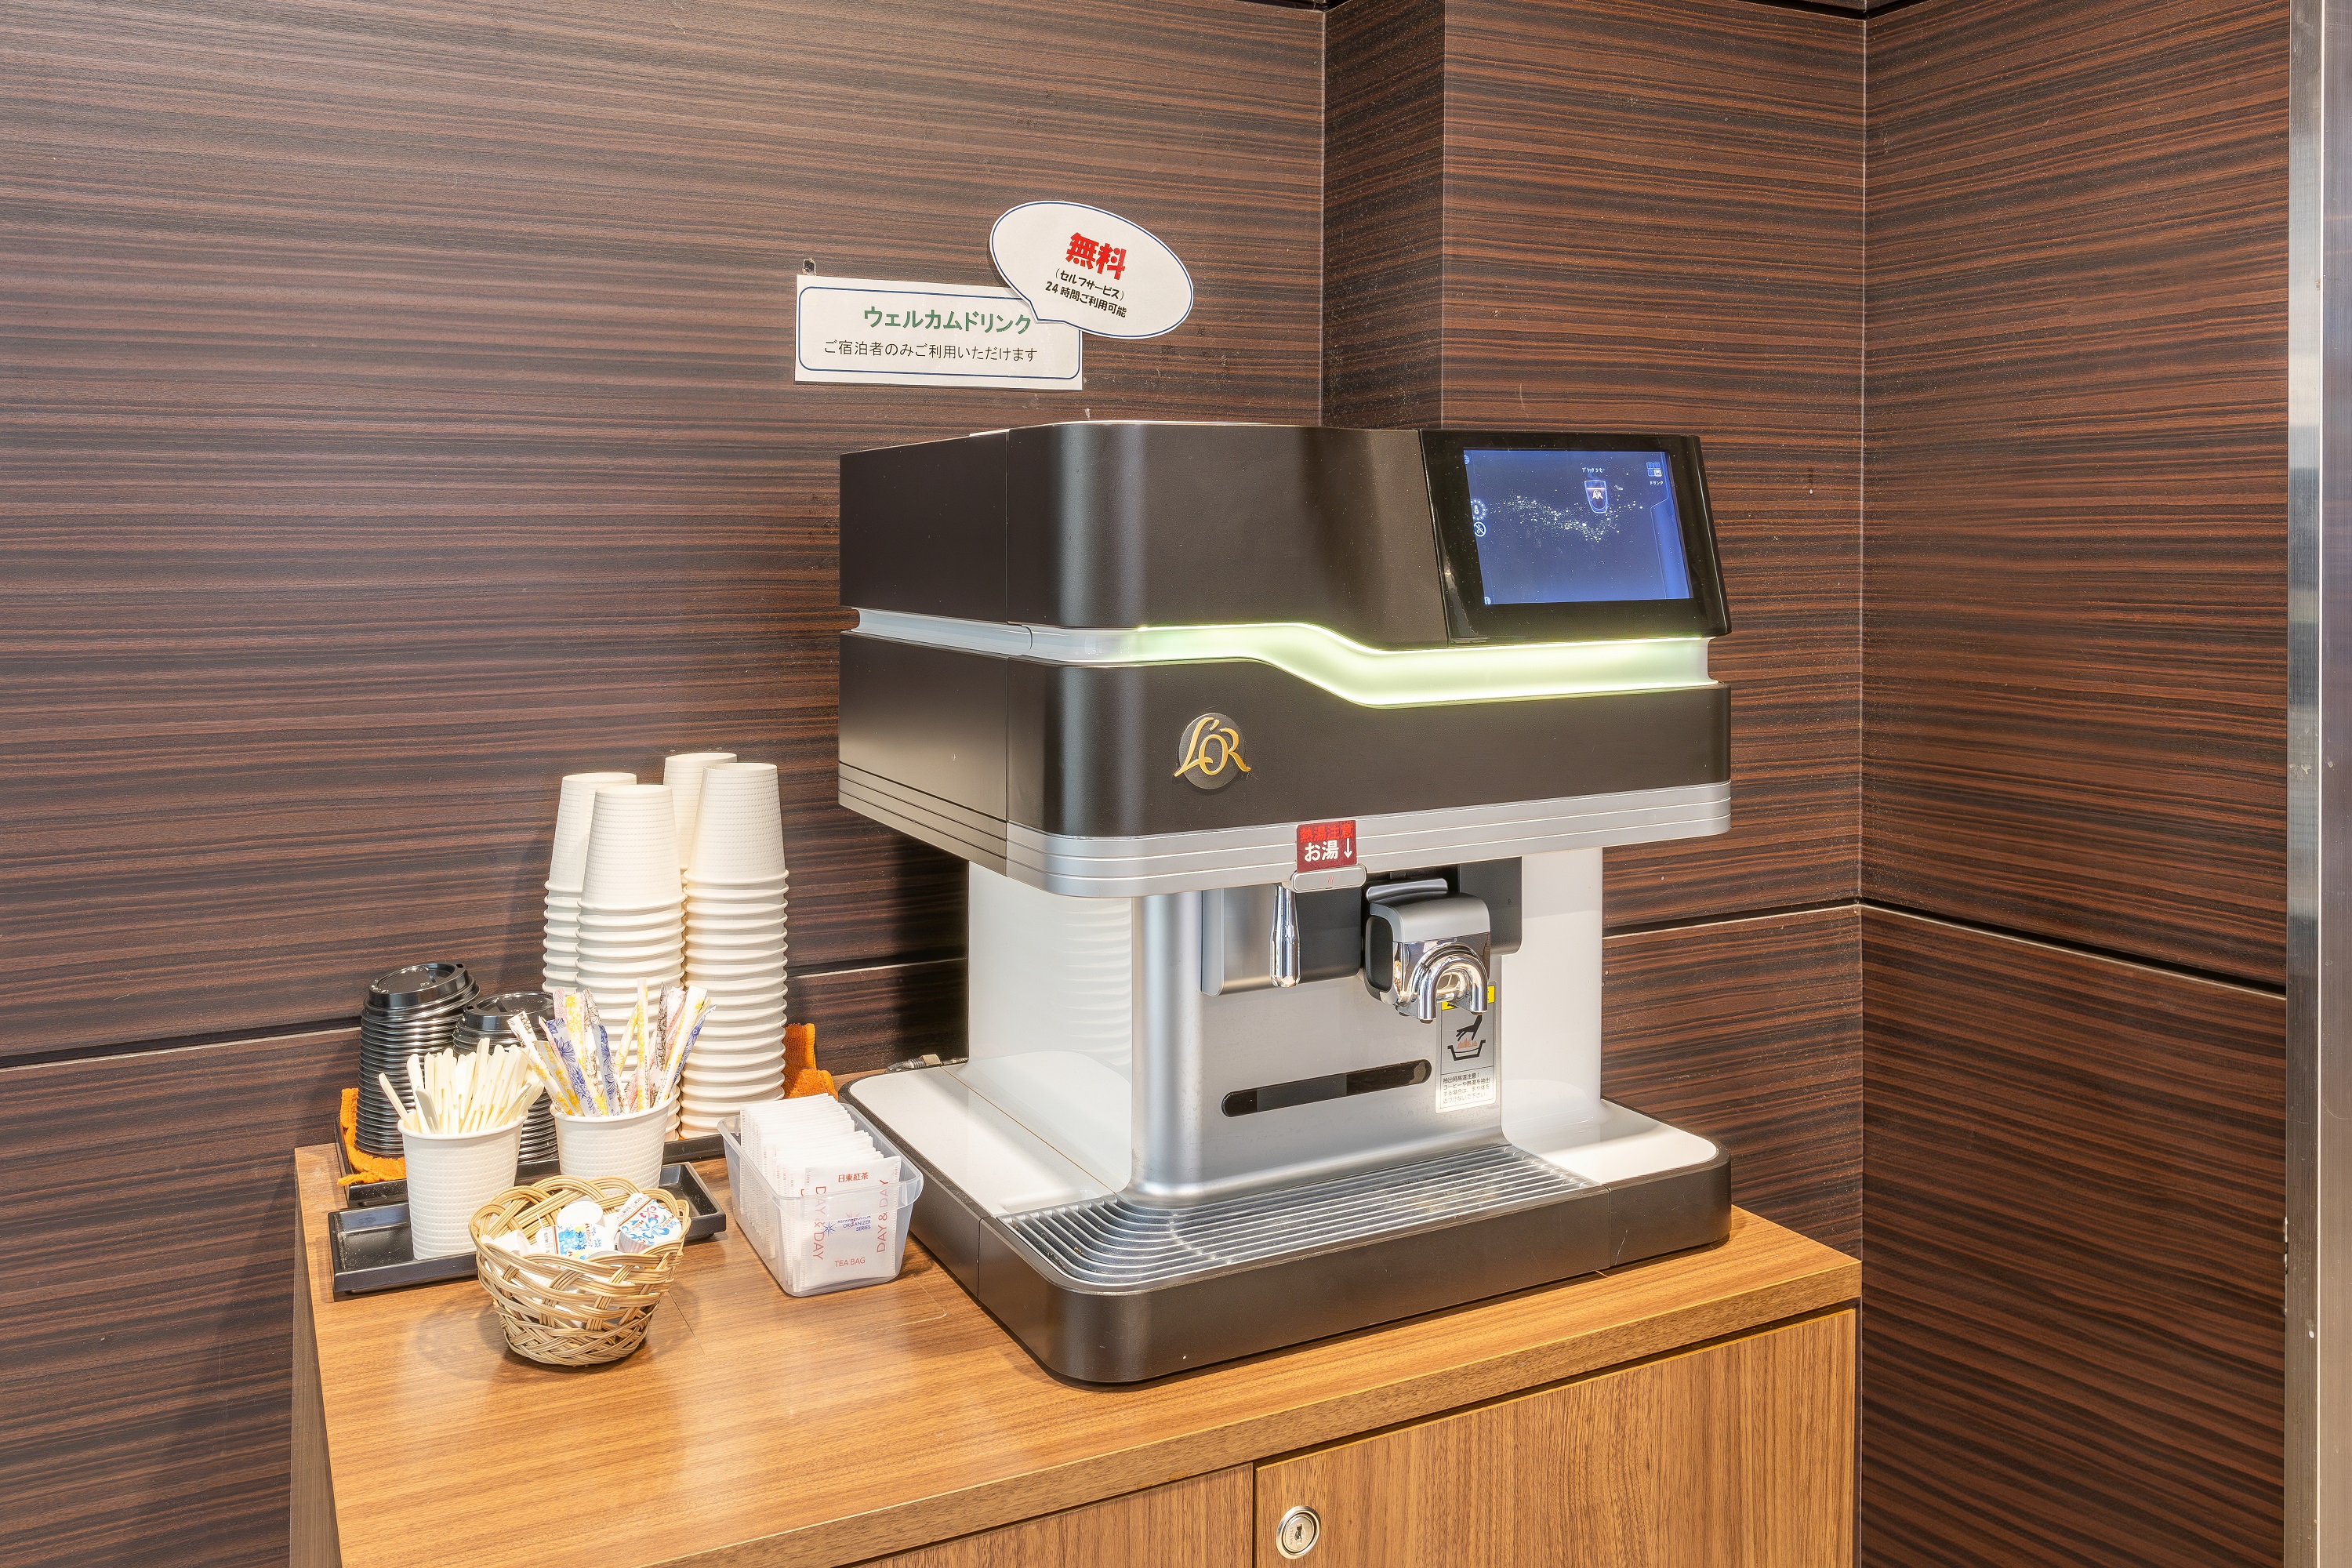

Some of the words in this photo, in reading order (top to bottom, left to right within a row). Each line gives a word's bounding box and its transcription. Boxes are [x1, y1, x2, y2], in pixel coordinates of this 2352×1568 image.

[1065, 232, 1127, 281] 無料
[864, 306, 1031, 335] ウェルカムドリンク
[824, 339, 1038, 362] ご宿泊者のみご利用いただけます
[1300, 822, 1354, 844] 熱湯注意
[1304, 840, 1340, 862] お湯
[838, 1172, 869, 1183] 日東紅茶
[815, 1186, 826, 1215] DAY
[879, 1179, 889, 1208] DAY
[843, 1220, 871, 1229] ORGANIZER
[878, 1211, 888, 1221] &
[813, 1232, 825, 1261] DAY
[877, 1225, 887, 1253] DAY
[834, 1259, 849, 1268] TEA
[850, 1257, 866, 1266] BAG
